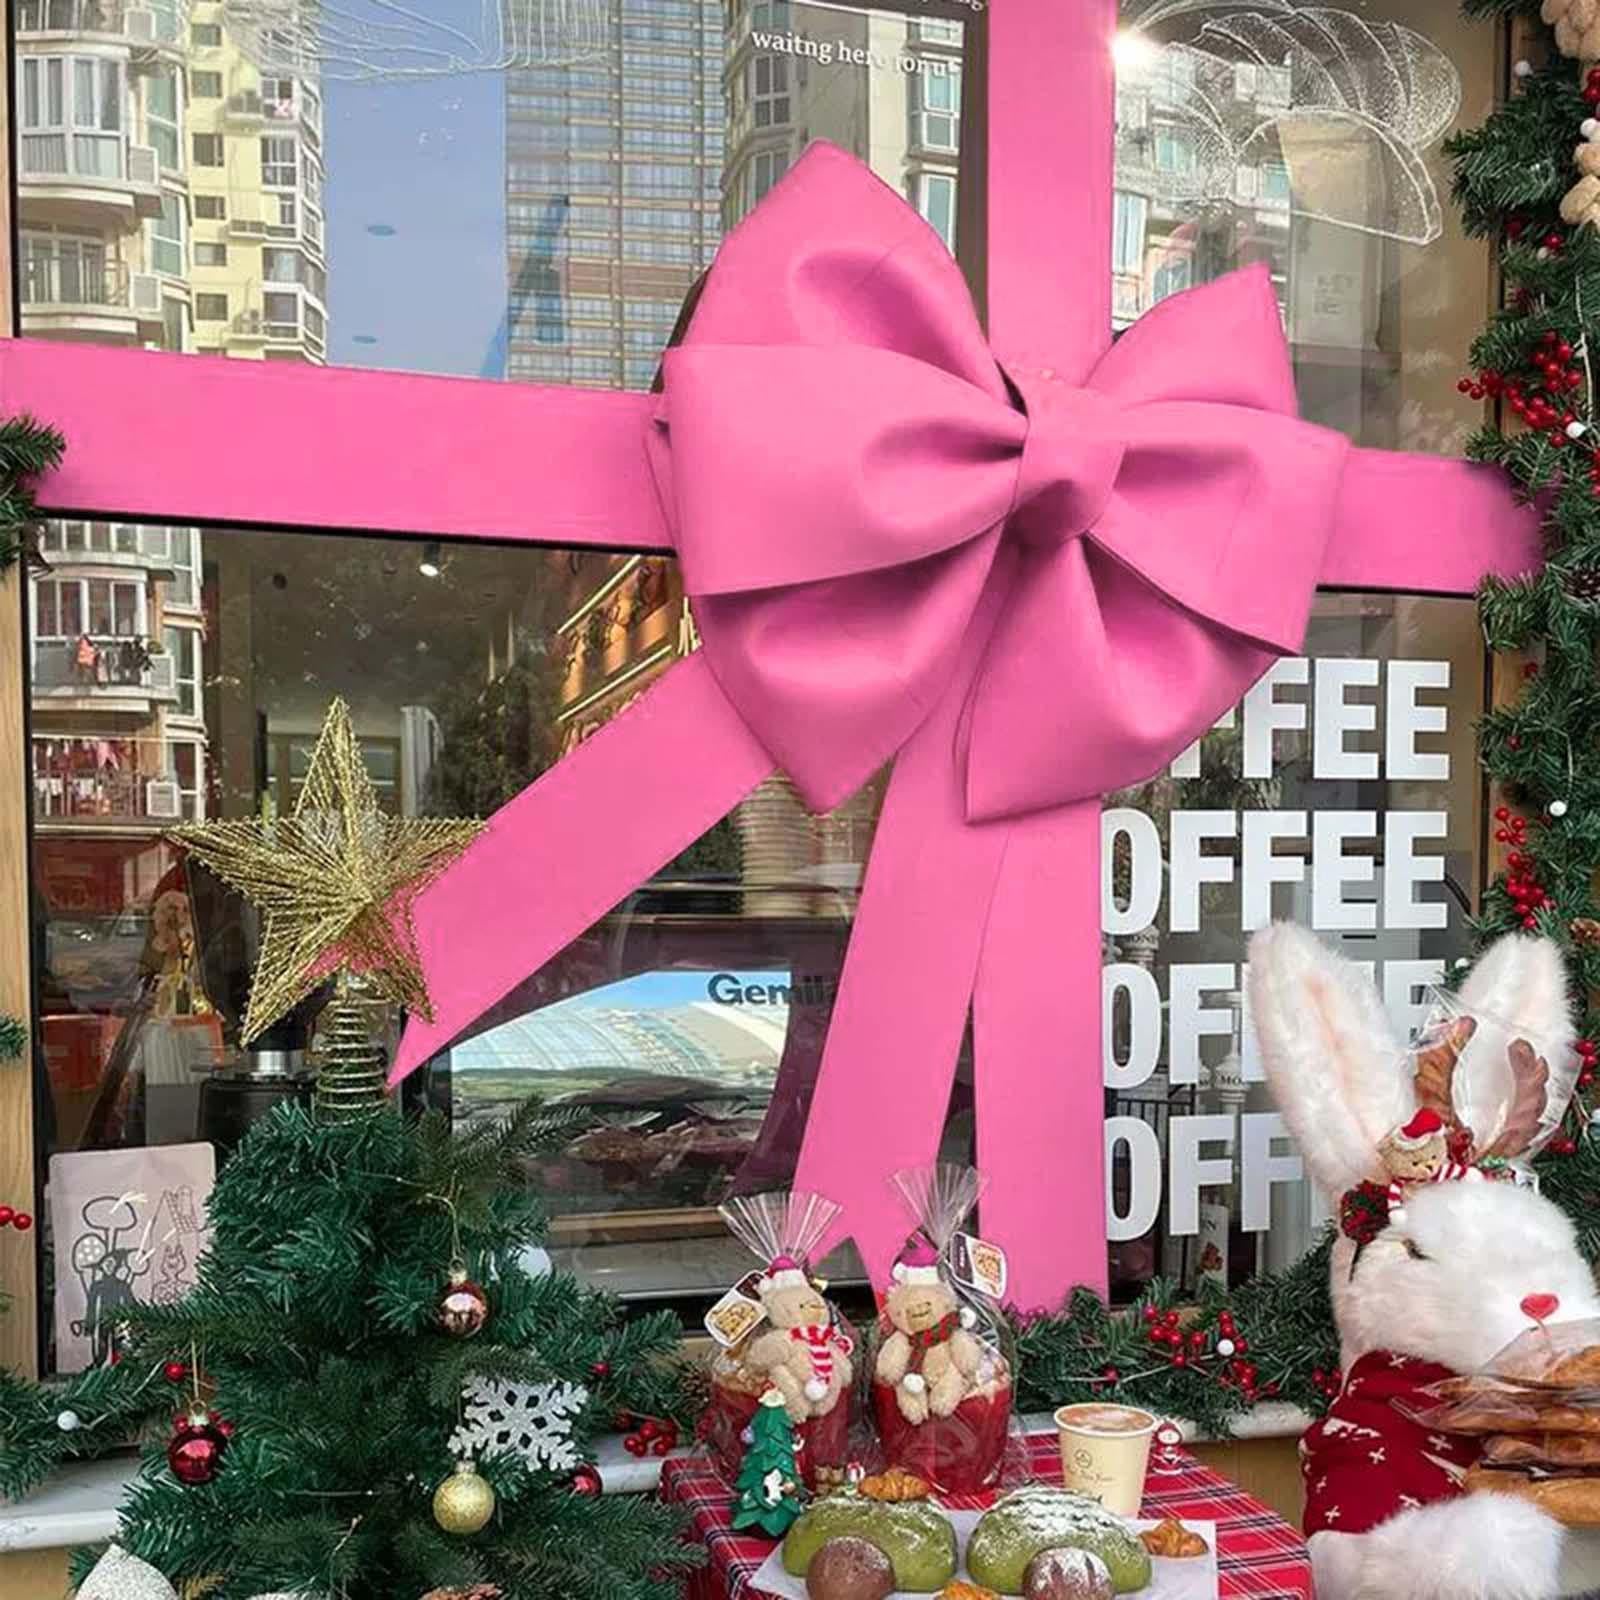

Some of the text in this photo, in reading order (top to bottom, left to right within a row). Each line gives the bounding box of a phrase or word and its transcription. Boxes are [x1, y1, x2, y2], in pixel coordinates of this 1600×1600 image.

[751, 31, 832, 64] waitng
[1101, 807, 1448, 935] OFFEE
[1103, 1113, 1328, 1242] OFF
